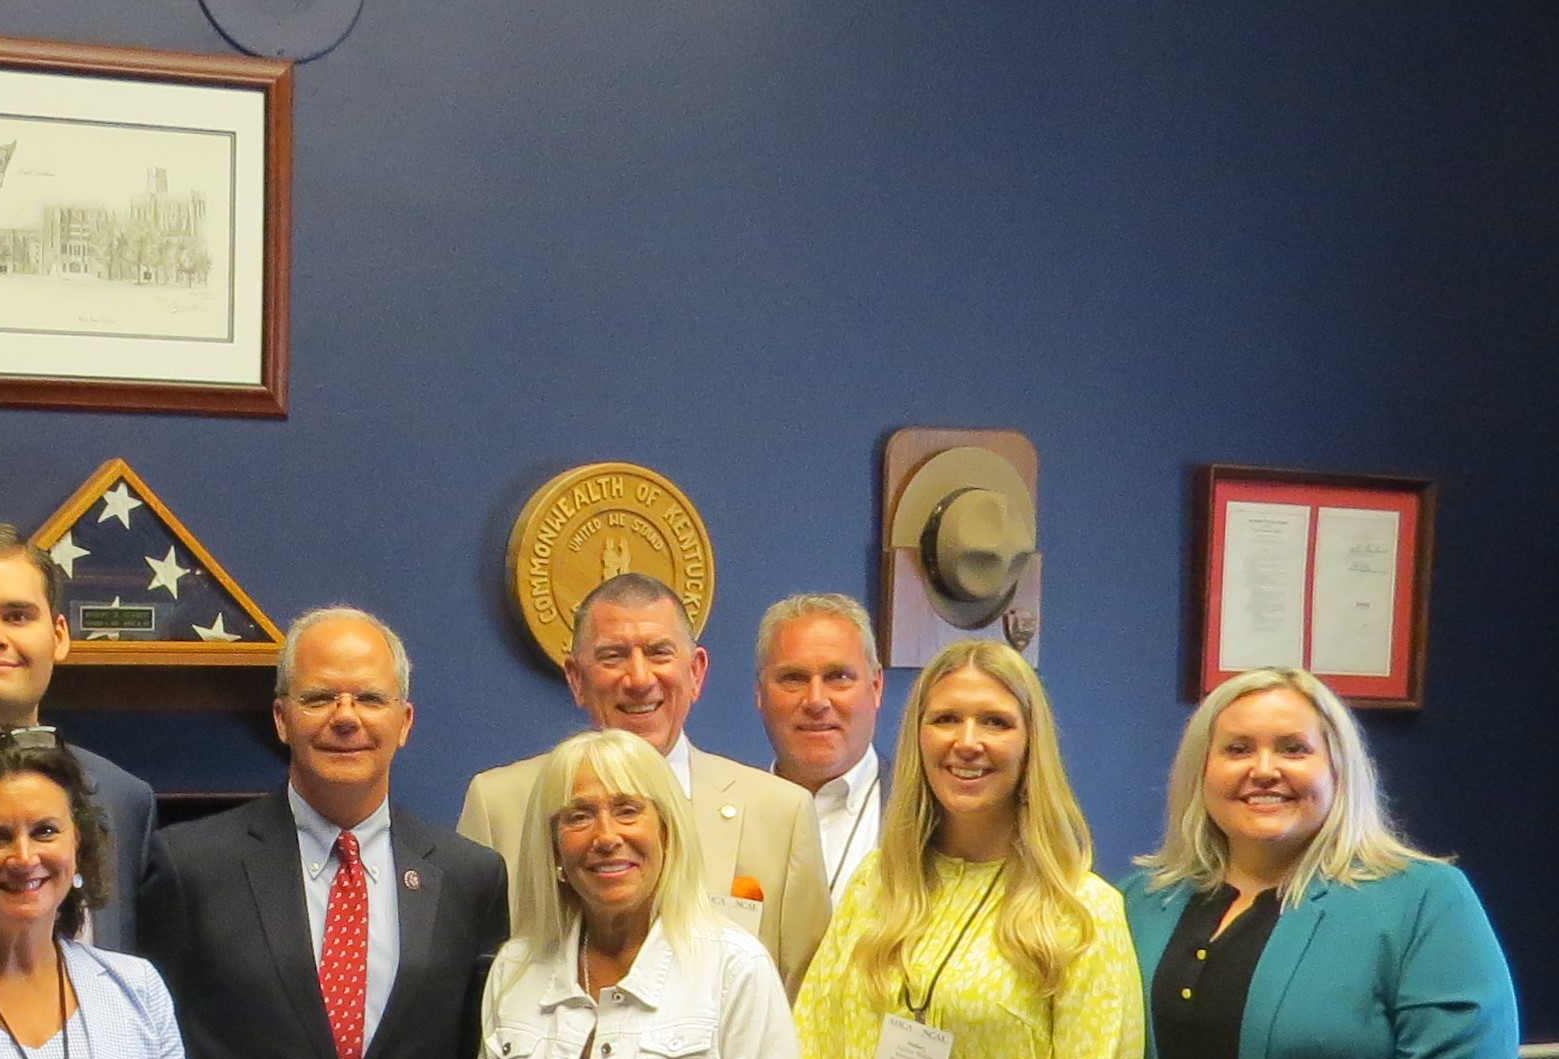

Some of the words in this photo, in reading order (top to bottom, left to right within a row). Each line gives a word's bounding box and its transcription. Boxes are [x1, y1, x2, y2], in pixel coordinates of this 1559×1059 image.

[530, 477, 624, 624] COMMONWEALTH
[636, 484, 662, 506] OF
[663, 504, 705, 624] KENTUCKY
[569, 518, 601, 552] UNITED
[608, 512, 627, 527] WE
[632, 519, 663, 551] STAND
